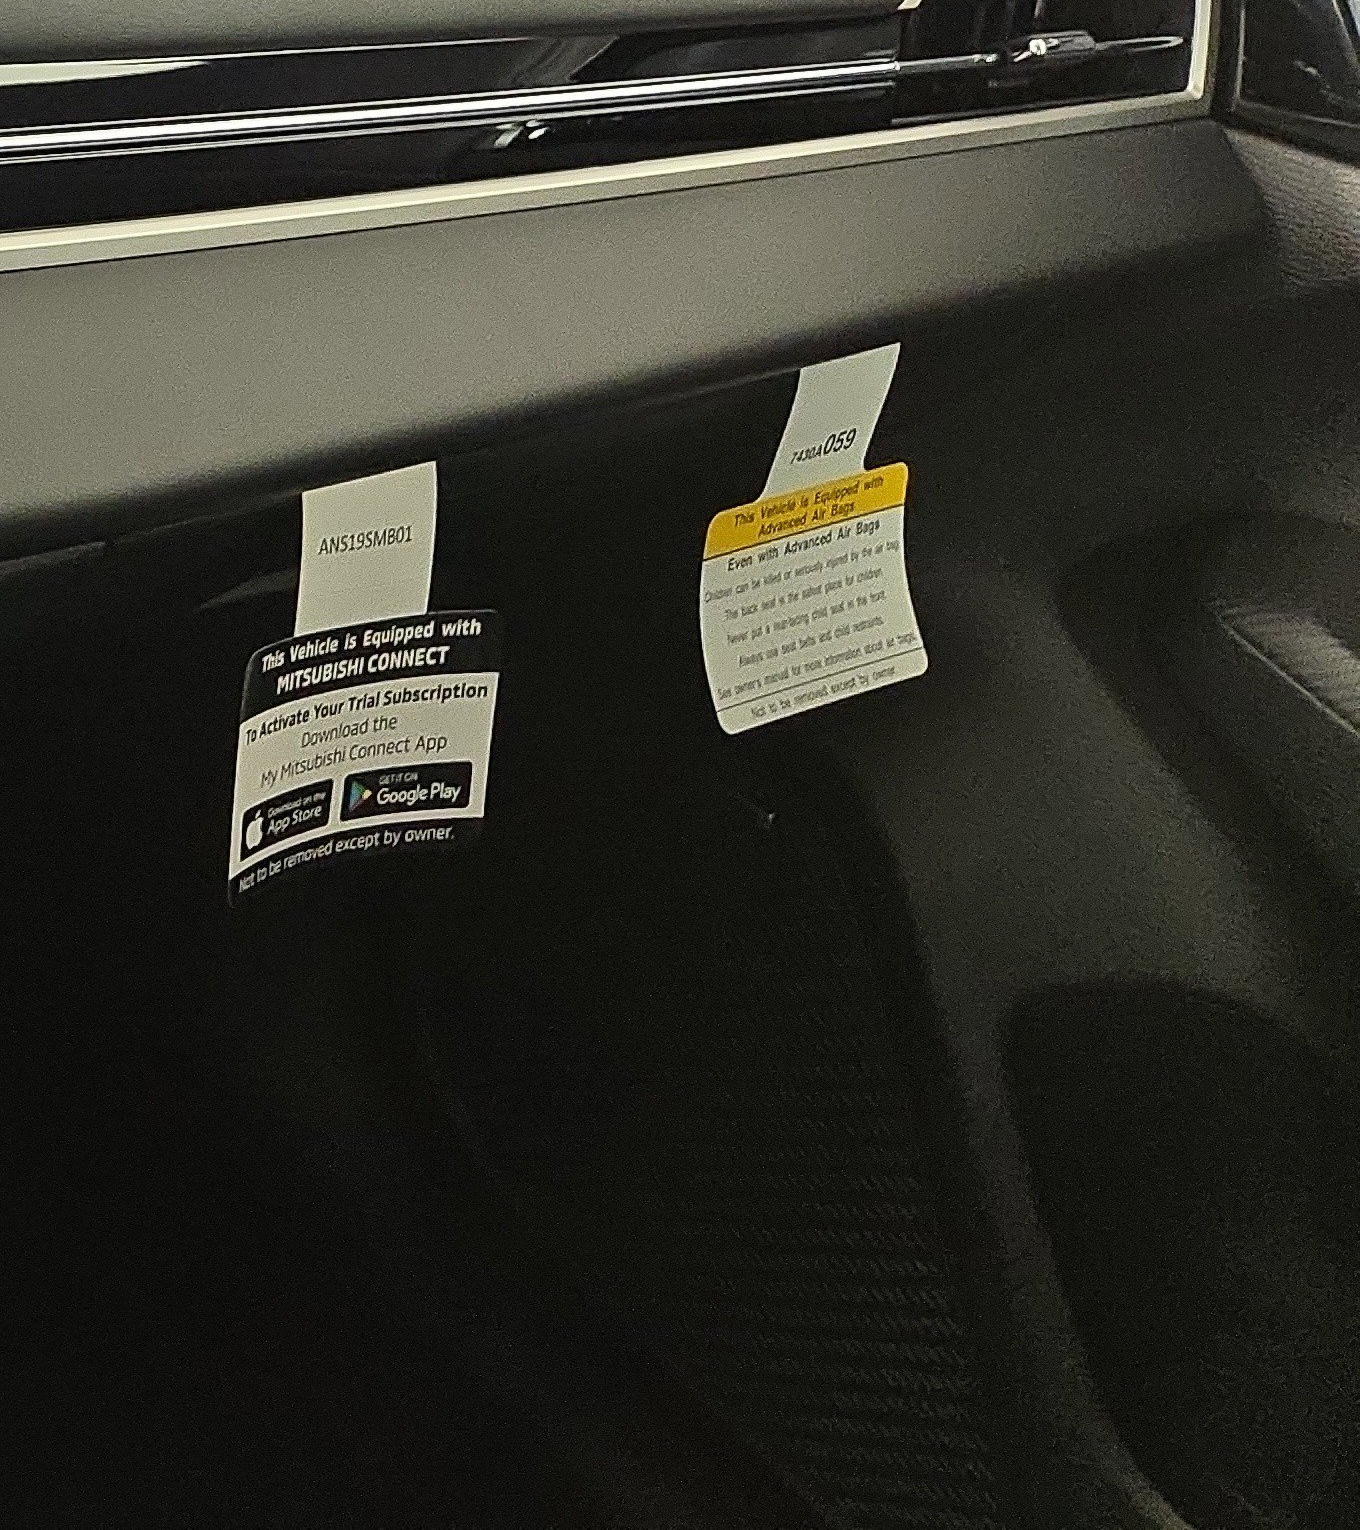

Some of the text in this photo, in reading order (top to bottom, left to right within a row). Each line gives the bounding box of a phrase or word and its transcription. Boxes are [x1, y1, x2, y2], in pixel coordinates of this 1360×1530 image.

[734, 512, 755, 527] This
[813, 480, 860, 505] Equipped
[864, 475, 884, 491] with
[758, 501, 855, 539] Advanced Air Bags
[727, 519, 880, 571] Even with Advanced Air Bags
[261, 652, 285, 673] This
[290, 637, 339, 664] Vehicle
[362, 620, 435, 650] Equipped
[442, 618, 482, 638] with
[276, 645, 451, 696] MITSUBISHI CONNECT
[246, 681, 488, 746] To Activate Your Trial Subscription
[300, 715, 398, 749] Download the
[279, 746, 347, 781] Mitsubishi
[349, 734, 411, 761] Connect
[415, 734, 448, 754] App
[376, 781, 462, 806] Google Play
[266, 805, 323, 835] App Store
[238, 825, 455, 893] Not to be removed except by owner.
